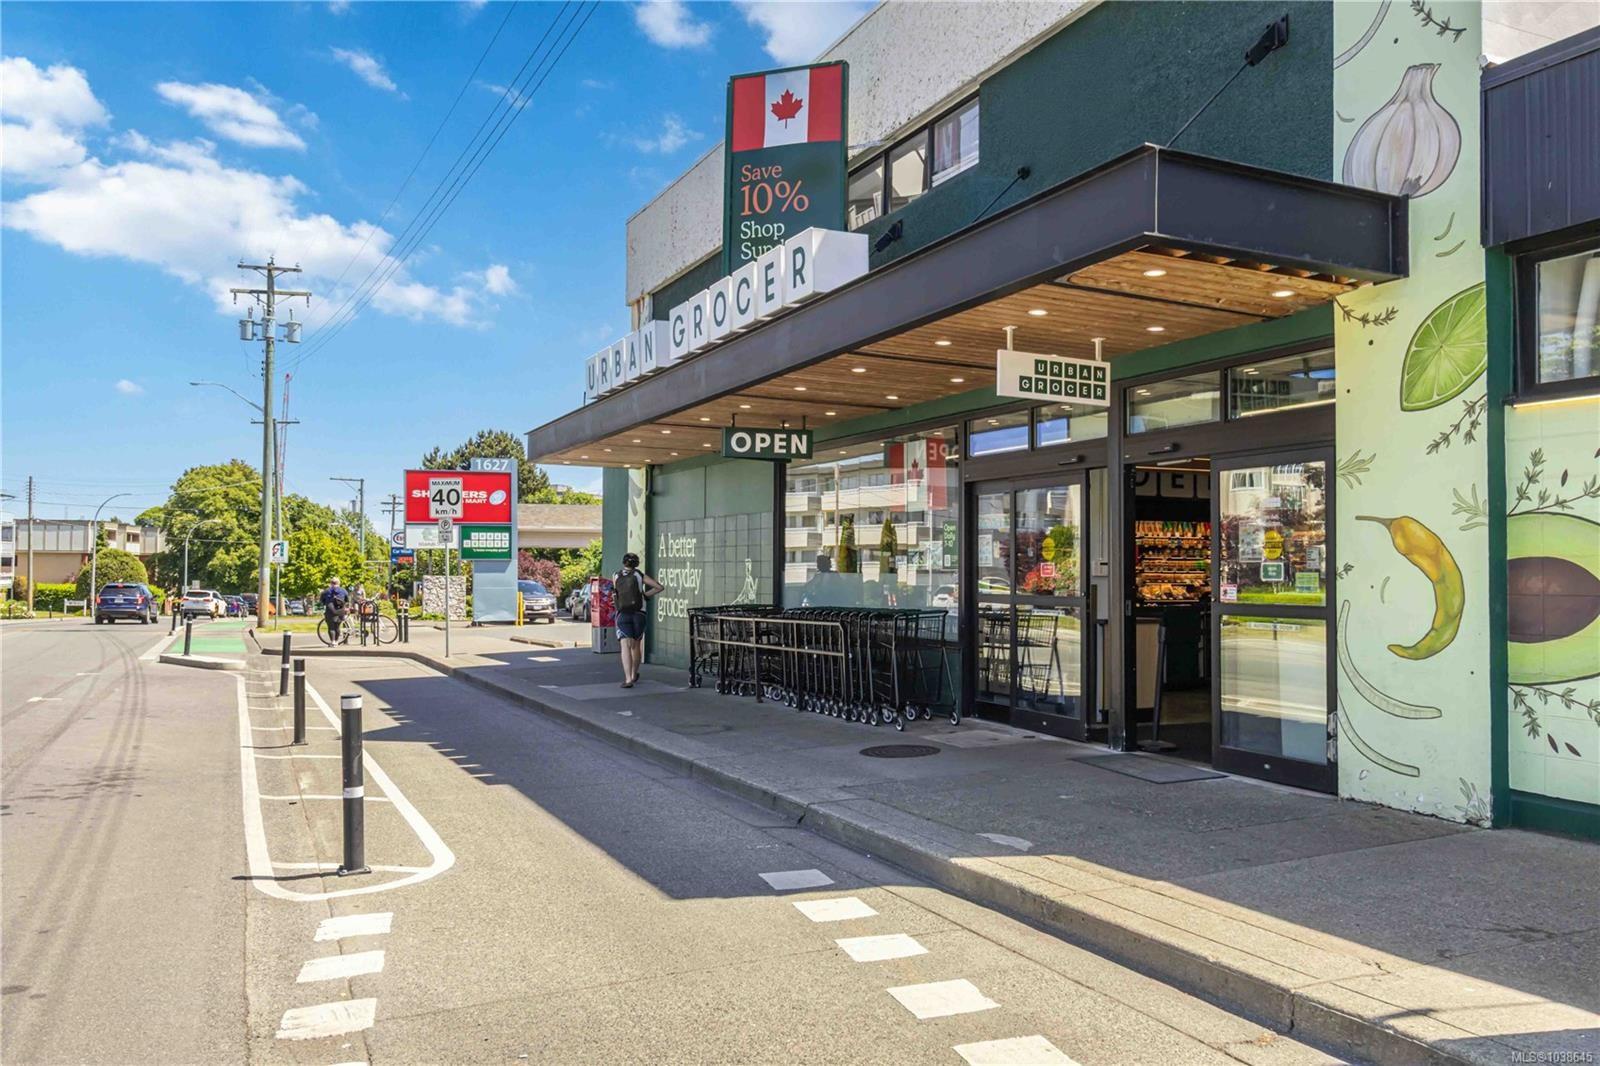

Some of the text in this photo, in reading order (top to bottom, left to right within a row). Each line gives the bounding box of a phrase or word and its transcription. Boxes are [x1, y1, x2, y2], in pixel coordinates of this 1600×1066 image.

[741, 164, 782, 182] Save
[740, 180, 809, 216] 10%
[740, 221, 785, 240] Shop
[588, 246, 806, 390] URBAN GROCER
[1038, 363, 1103, 379] URBAN
[1021, 379, 1103, 397] GROCER
[730, 432, 808, 455] OPEN
[476, 459, 509, 471] 1627
[431, 488, 461, 506] 40
[658, 533, 697, 558] A better
[657, 562, 702, 595] everyday
